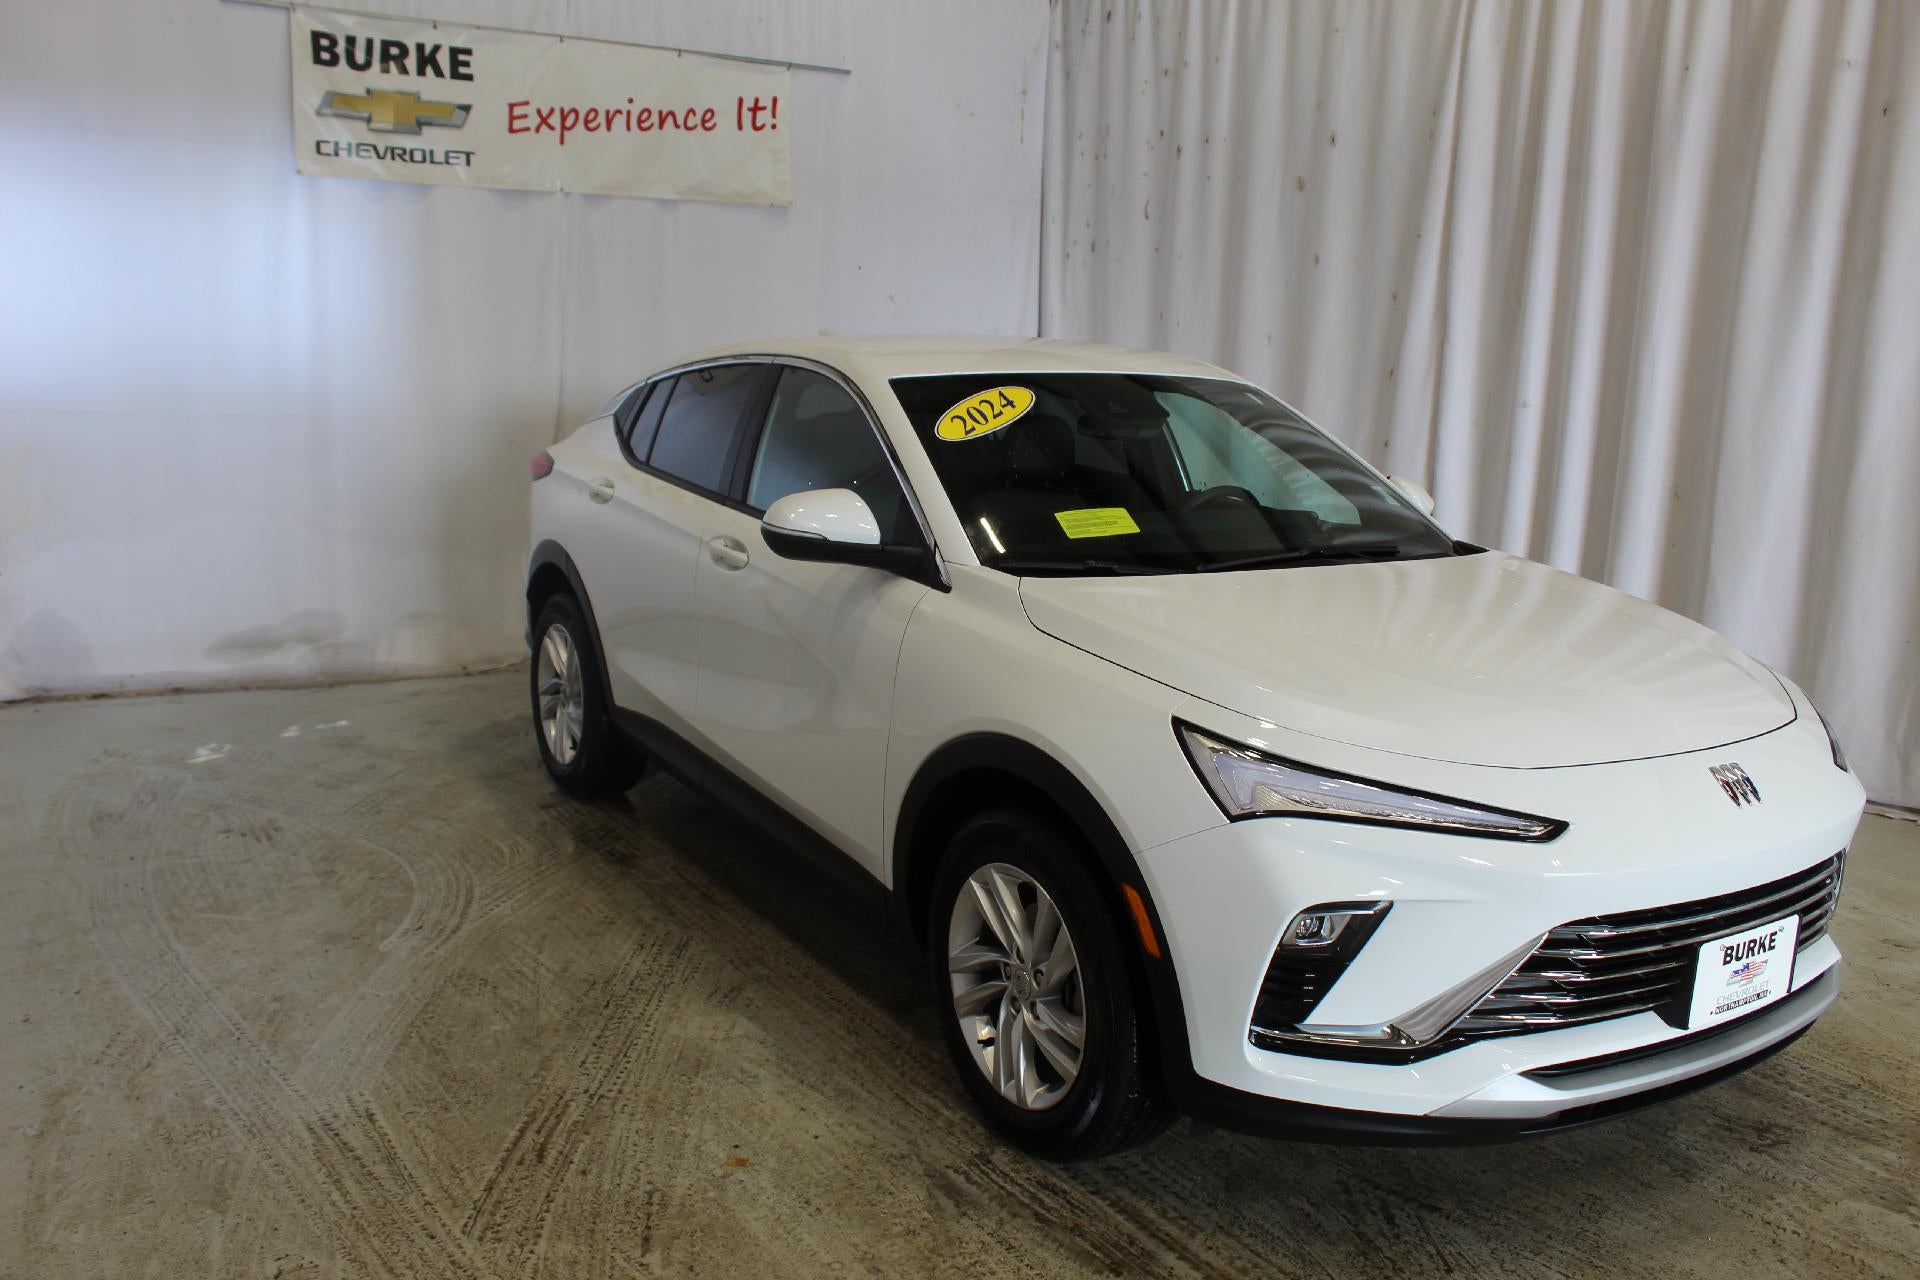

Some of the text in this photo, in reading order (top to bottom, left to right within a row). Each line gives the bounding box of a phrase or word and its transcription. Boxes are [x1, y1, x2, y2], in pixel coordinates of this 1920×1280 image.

[310, 30, 474, 81] BURKE
[507, 96, 778, 146] Experience It!
[315, 140, 476, 167] CHEVROLET
[950, 390, 1017, 436] 2024
[1722, 931, 1777, 966] BURKE
[1716, 980, 1769, 1005] CHEVROLET
